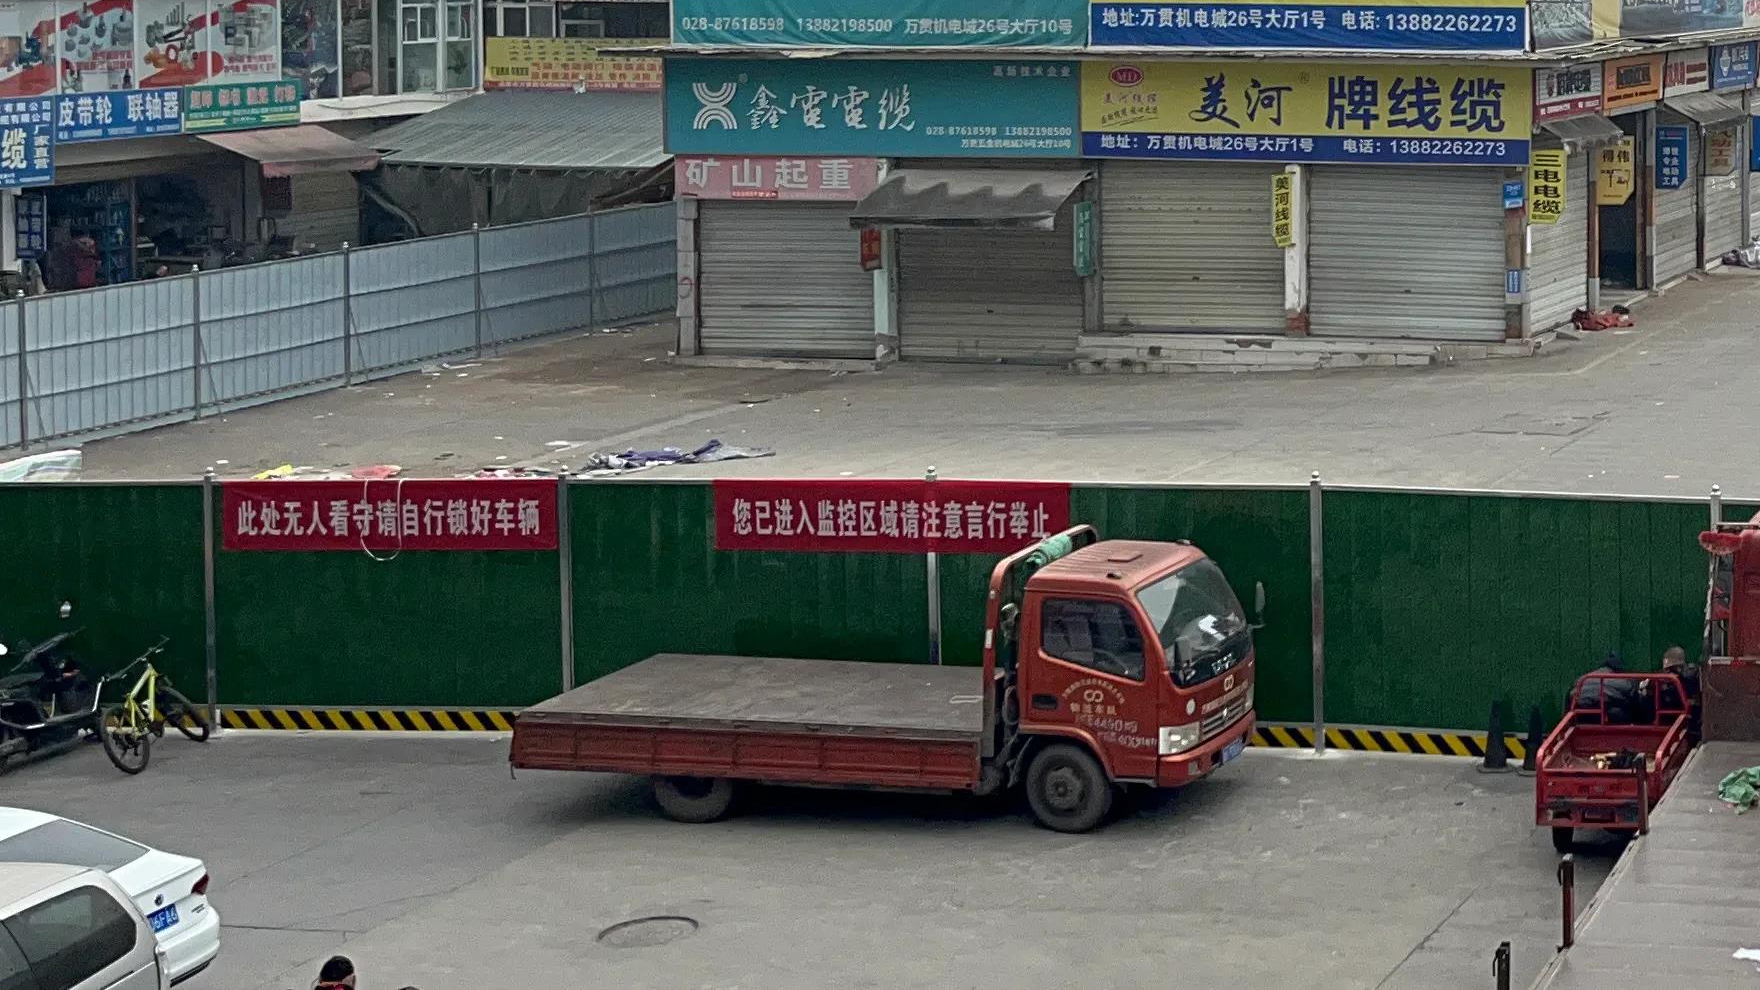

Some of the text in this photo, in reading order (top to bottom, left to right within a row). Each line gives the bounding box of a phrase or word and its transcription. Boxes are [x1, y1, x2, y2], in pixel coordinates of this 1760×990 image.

[682, 16, 1073, 35] 028-87618598 13882198500 万贯机电城26号大厅10号
[1385, 13, 1517, 33] 13882262273
[58, 95, 112, 127] 皮带轮
[128, 91, 179, 122] 联轴器
[1188, 72, 1293, 130] 美河
[1325, 76, 1505, 133] 牌线缆
[2, 127, 27, 170] 缆
[1147, 135, 1315, 153] 万贯机电城26号大厅1号
[1389, 139, 1506, 157] 13882262273
[685, 158, 853, 189] 矿山起重
[1532, 153, 1561, 215] 三电电缆
[1274, 177, 1290, 237] 美河线缆
[237, 498, 1052, 540] 此处无人看守请自行锁好车辆 您已进入监控区域请注意言行举止
